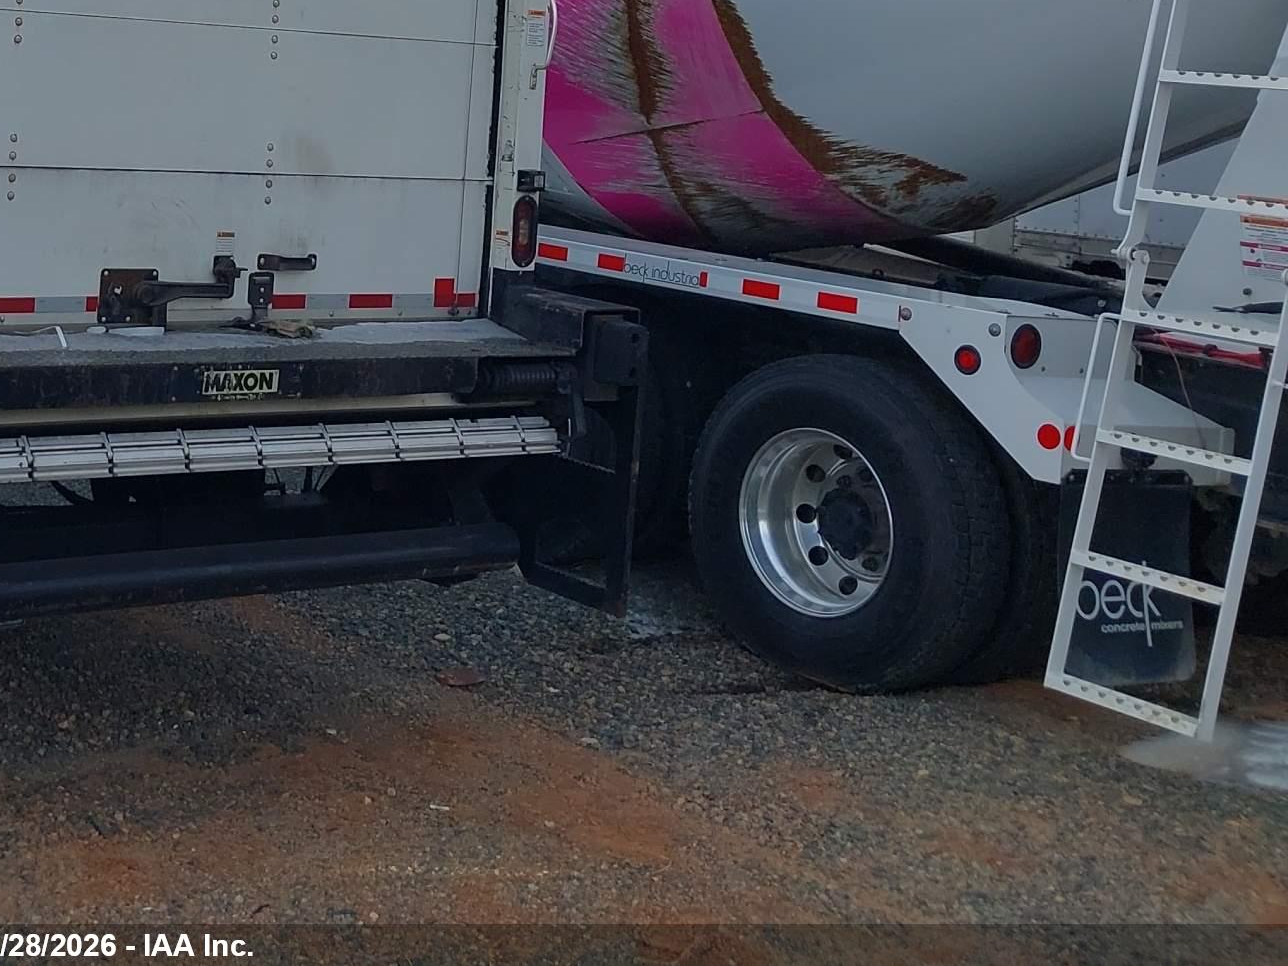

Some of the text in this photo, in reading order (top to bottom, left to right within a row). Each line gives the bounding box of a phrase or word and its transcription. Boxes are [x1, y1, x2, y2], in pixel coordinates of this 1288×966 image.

[623, 252, 649, 283] beck
[203, 371, 274, 393] MAXON
[1100, 622, 1146, 633] concrete
